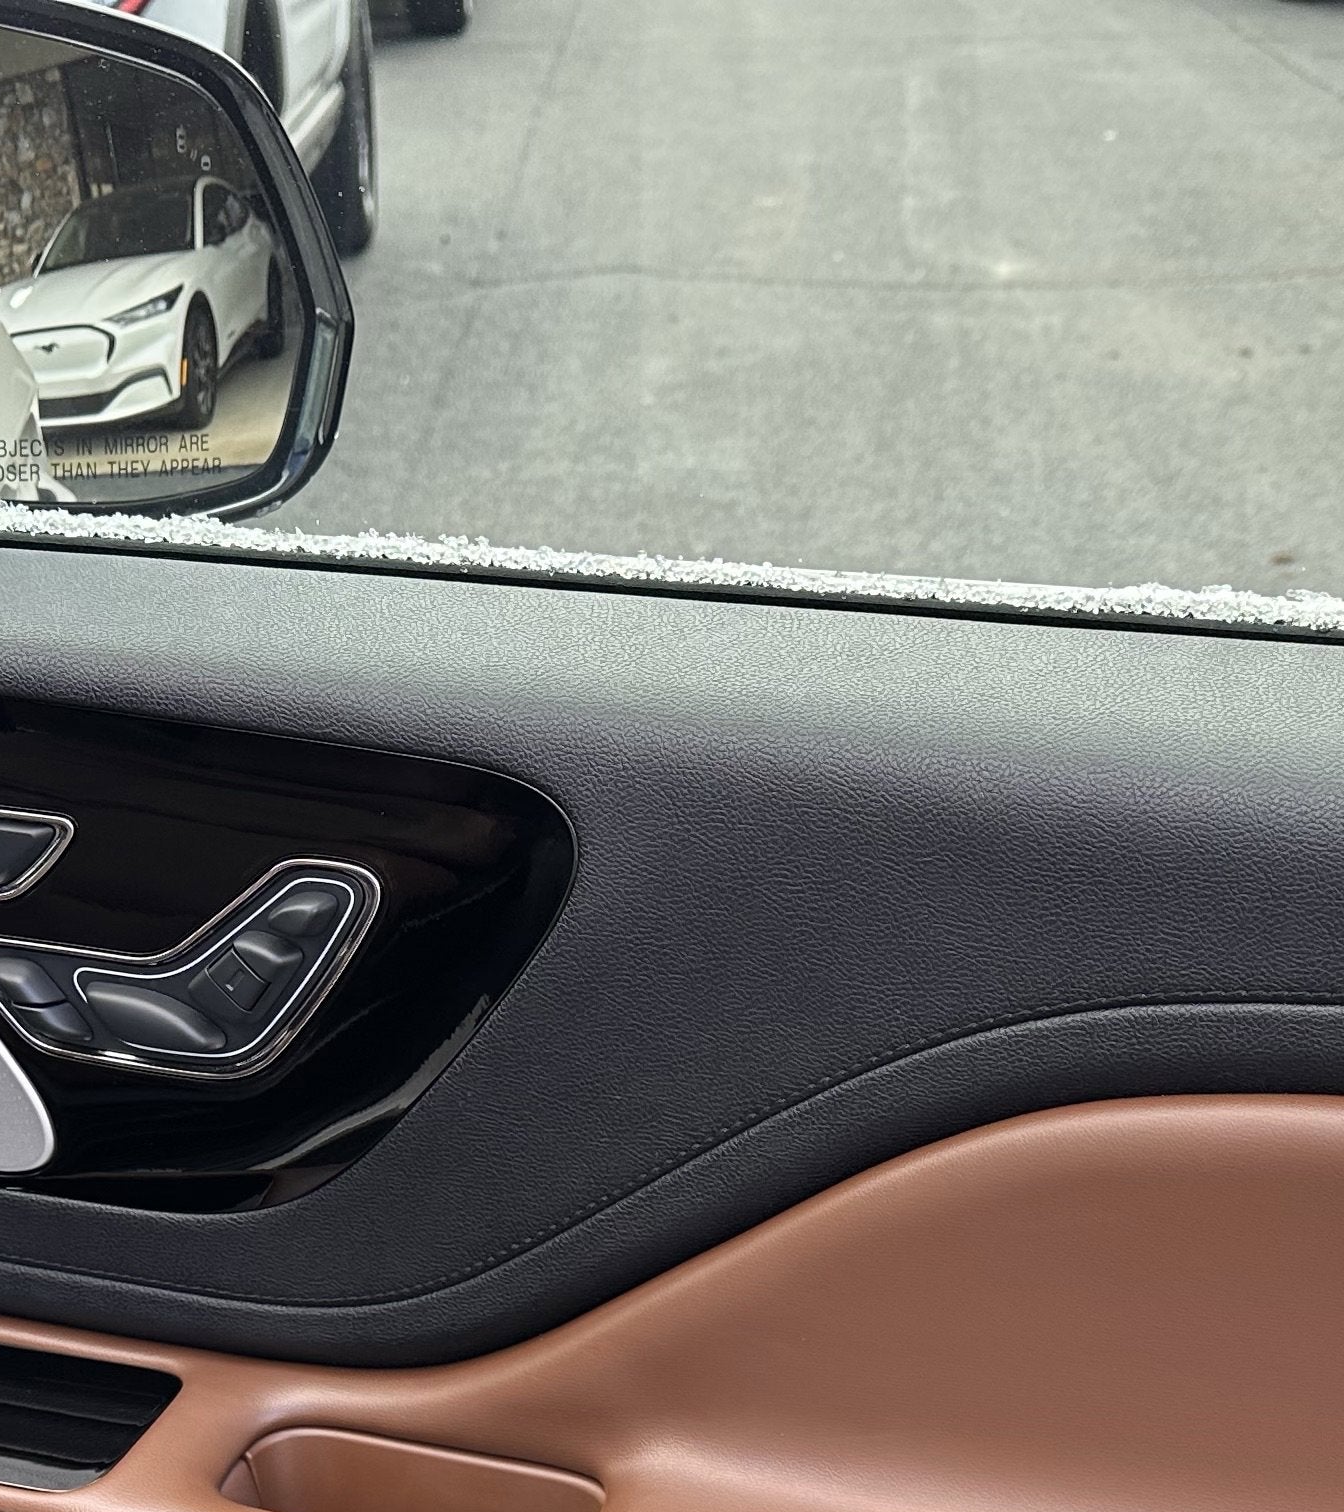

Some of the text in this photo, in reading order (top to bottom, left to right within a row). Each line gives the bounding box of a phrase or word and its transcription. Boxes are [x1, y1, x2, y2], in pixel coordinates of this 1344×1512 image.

[76, 440, 92, 456] IN
[104, 435, 168, 456] MIRROR
[179, 434, 210, 452] ARE
[51, 462, 97, 480] THAN
[108, 460, 151, 478] THEY
[159, 457, 222, 476] APPEAR
